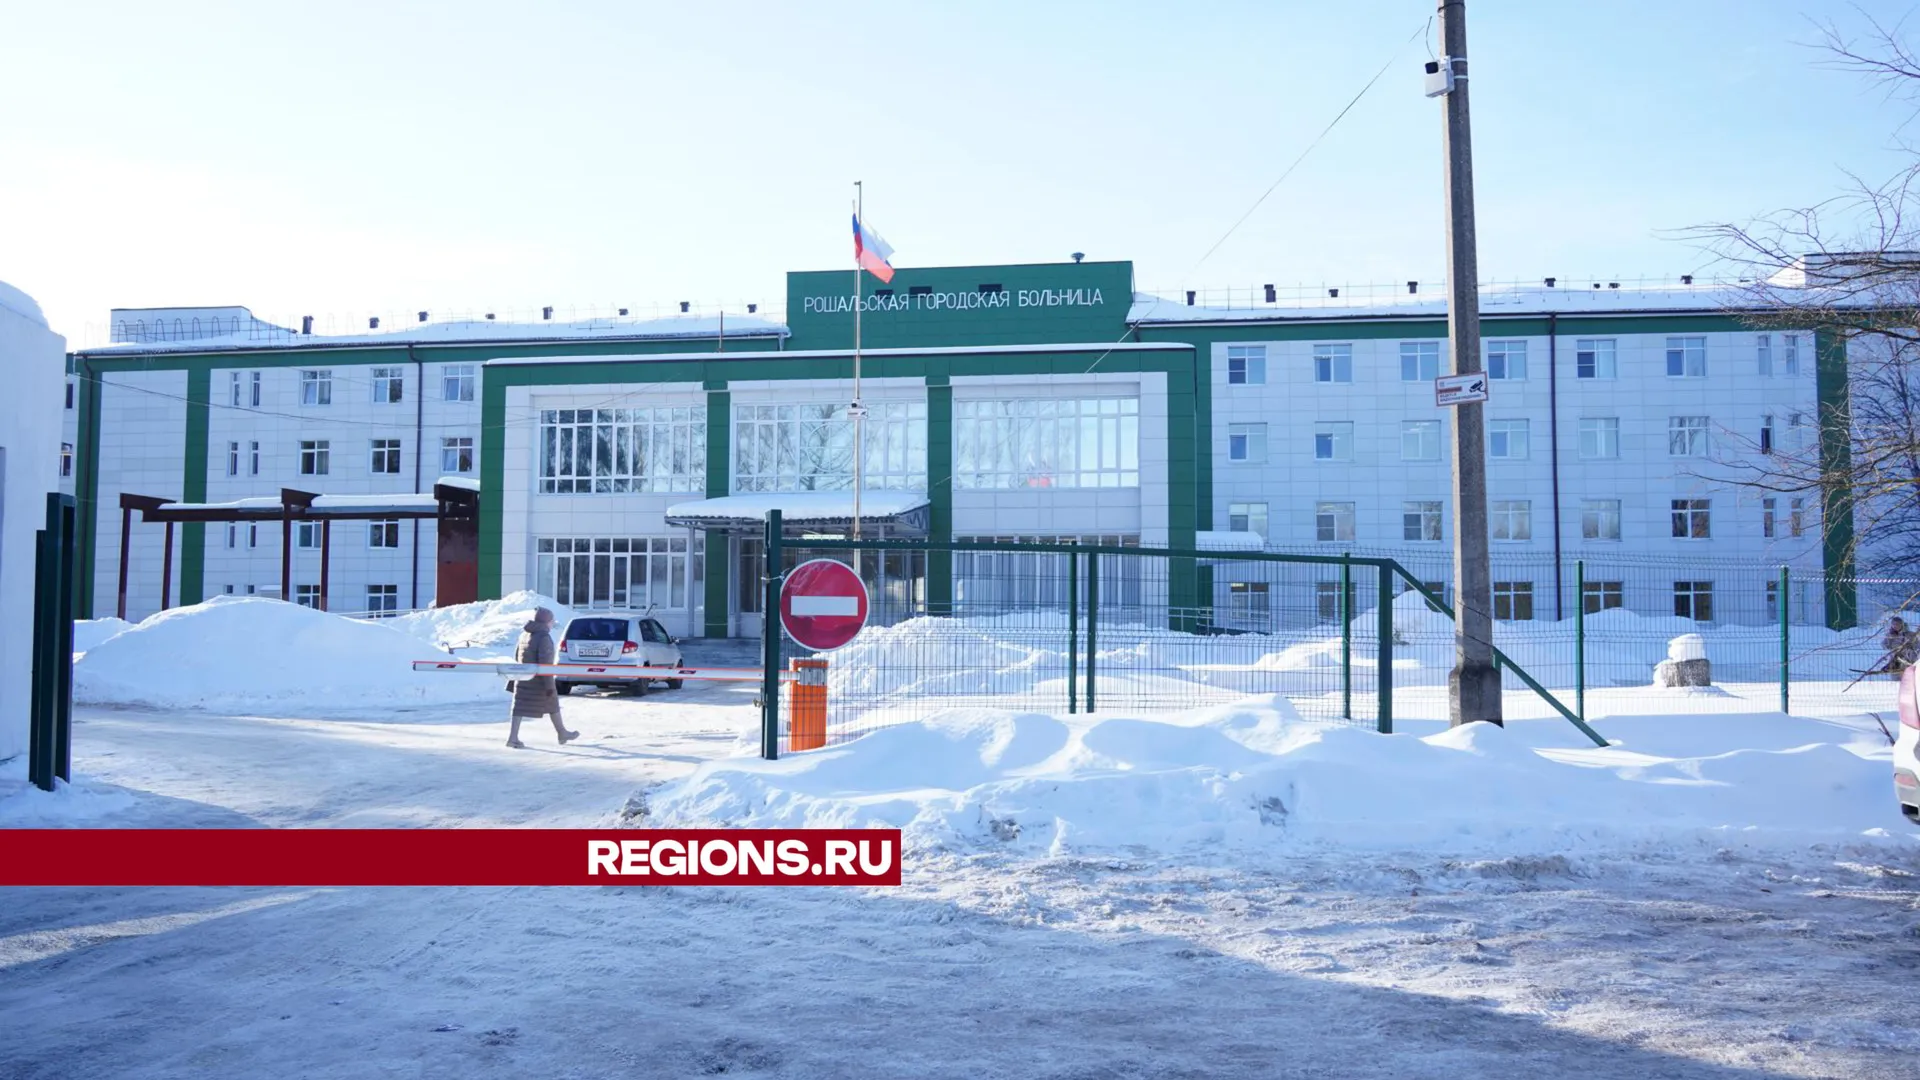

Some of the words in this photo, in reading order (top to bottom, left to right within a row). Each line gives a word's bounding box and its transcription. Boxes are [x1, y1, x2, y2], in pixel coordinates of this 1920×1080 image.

[804, 293, 909, 313] РОШАЛЬСКАЯ
[917, 290, 1010, 310] ГОРОДСКАЯ
[1018, 288, 1104, 307] БОЛЬНИЦА
